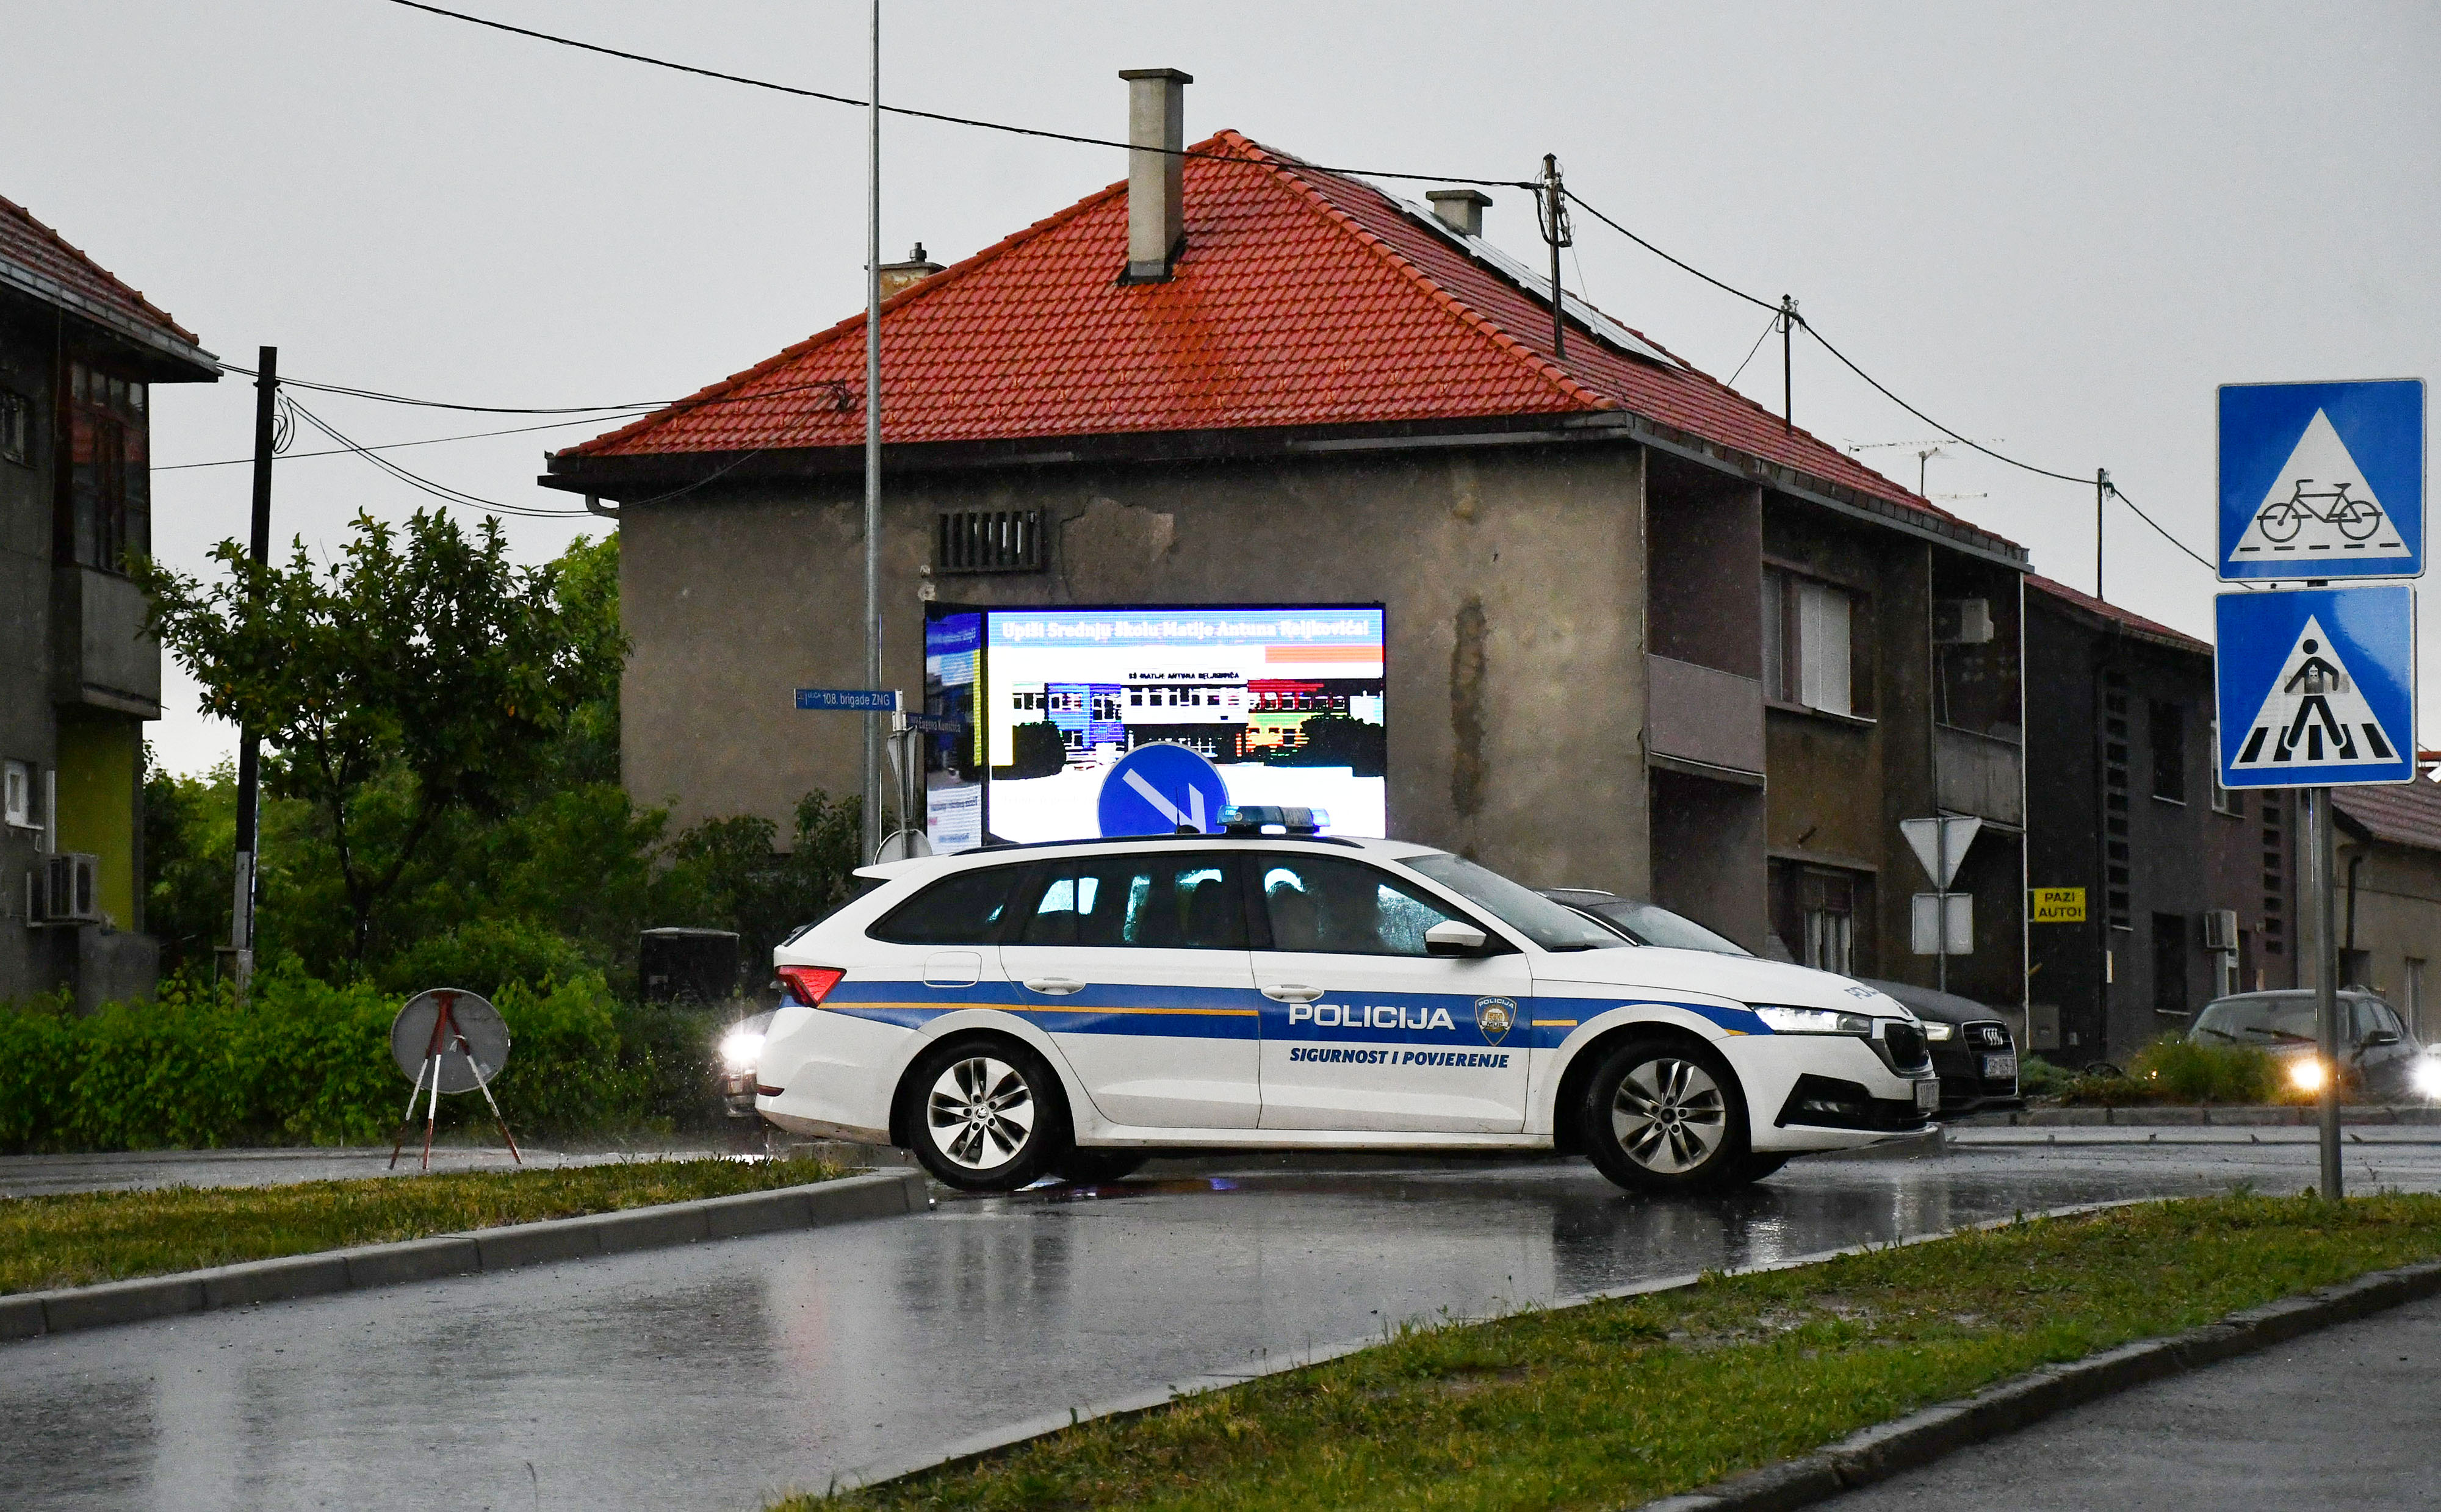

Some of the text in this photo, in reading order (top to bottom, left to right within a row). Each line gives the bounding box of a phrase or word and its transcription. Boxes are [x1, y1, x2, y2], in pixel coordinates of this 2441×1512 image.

[1047, 621, 1111, 641] Srednju
[1162, 620, 1214, 639] Matije
[1217, 621, 1277, 636] Antuna
[821, 693, 890, 707] 108. brigade ZNG
[2044, 893, 2075, 902] PAZI
[1478, 998, 1514, 1009] POLICIJA
[1289, 1004, 1456, 1031] POLICIJA
[1289, 1048, 1510, 1068] SIGURNOST I POVJERENJE
